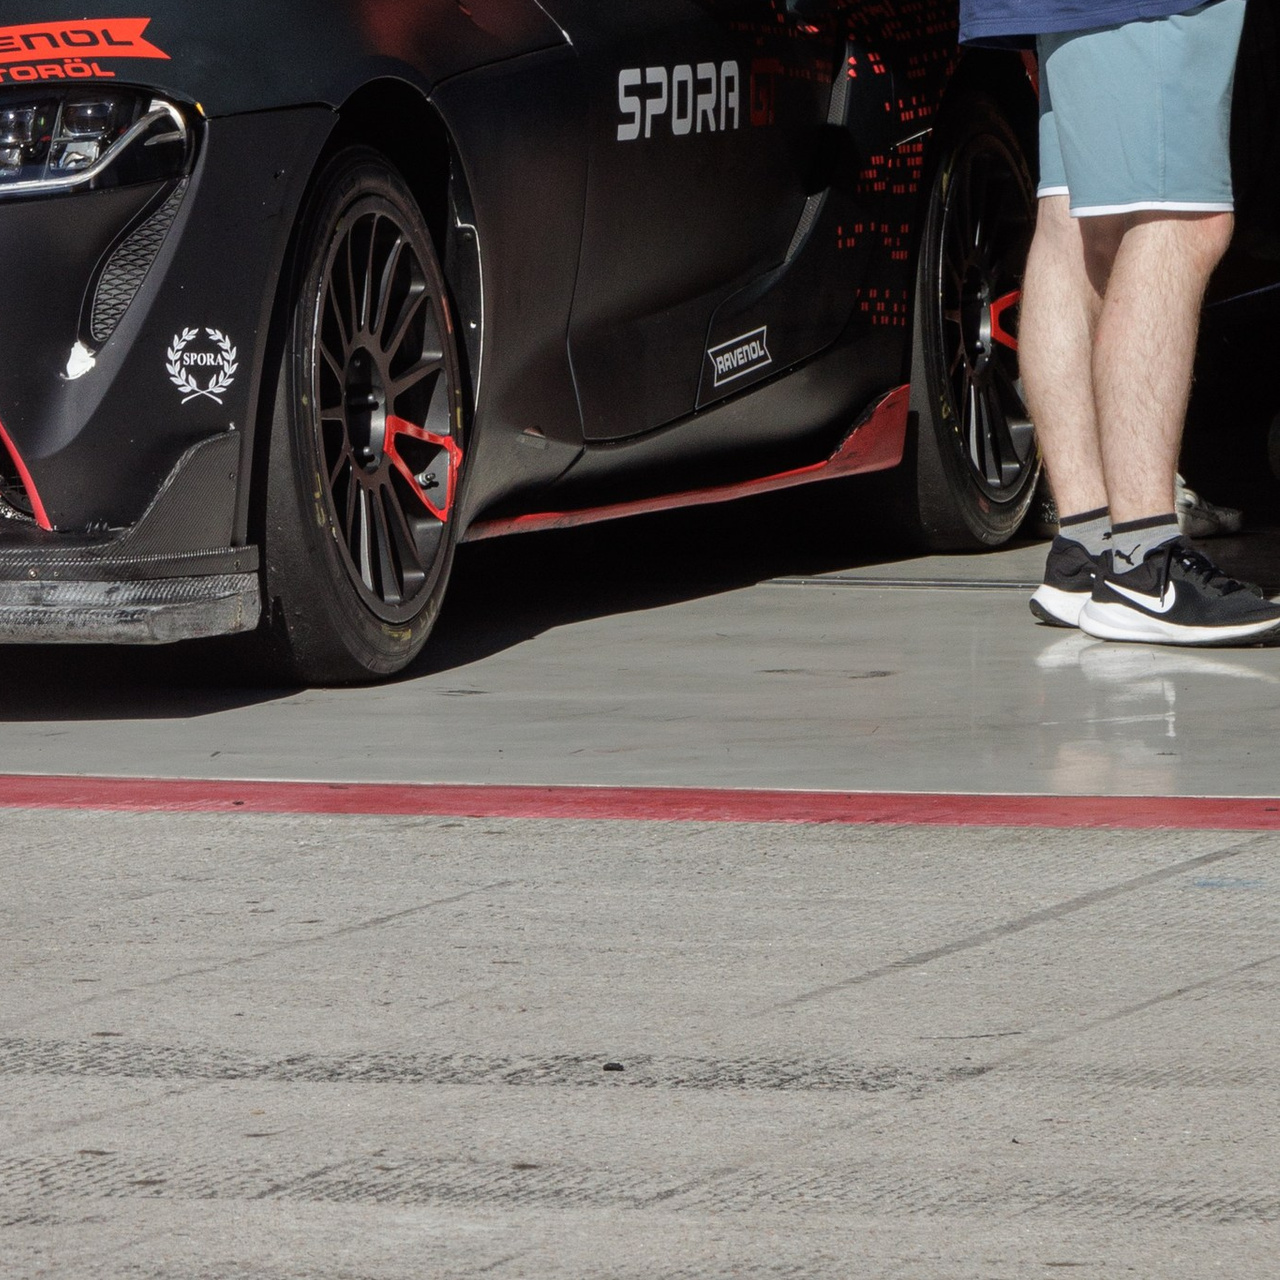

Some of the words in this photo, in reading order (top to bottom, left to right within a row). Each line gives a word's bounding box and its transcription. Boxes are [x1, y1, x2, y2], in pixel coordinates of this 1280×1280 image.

[617, 59, 740, 142] SPORA
[183, 352, 224, 366] SPORA
[716, 340, 765, 374] RAVENOL
